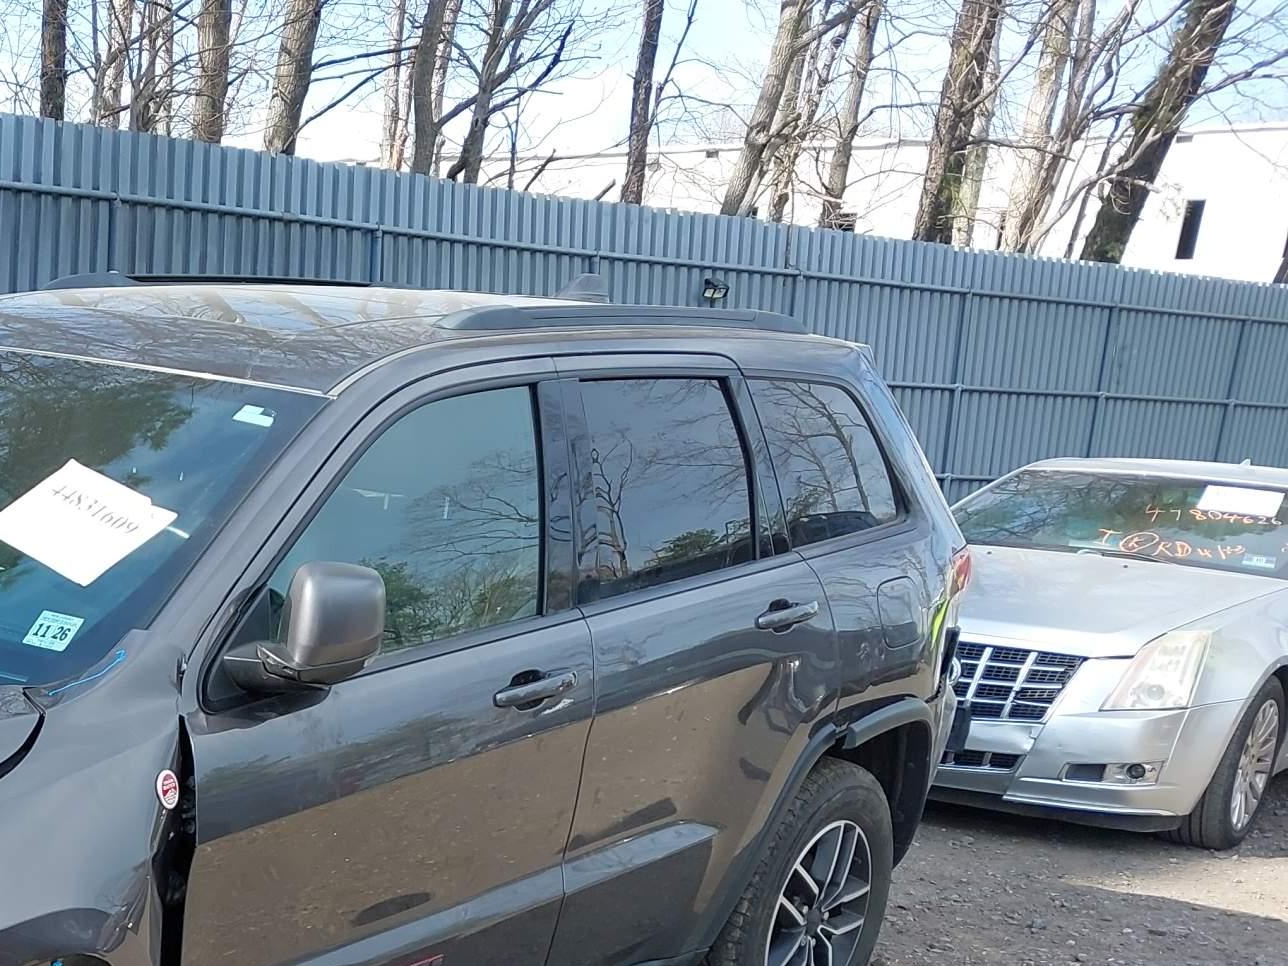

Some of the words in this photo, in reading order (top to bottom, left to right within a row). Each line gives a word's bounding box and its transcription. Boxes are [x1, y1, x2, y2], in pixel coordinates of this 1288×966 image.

[51, 485, 140, 534] 44831609
[32, 623, 51, 638] 11
[51, 626, 71, 641] 26
